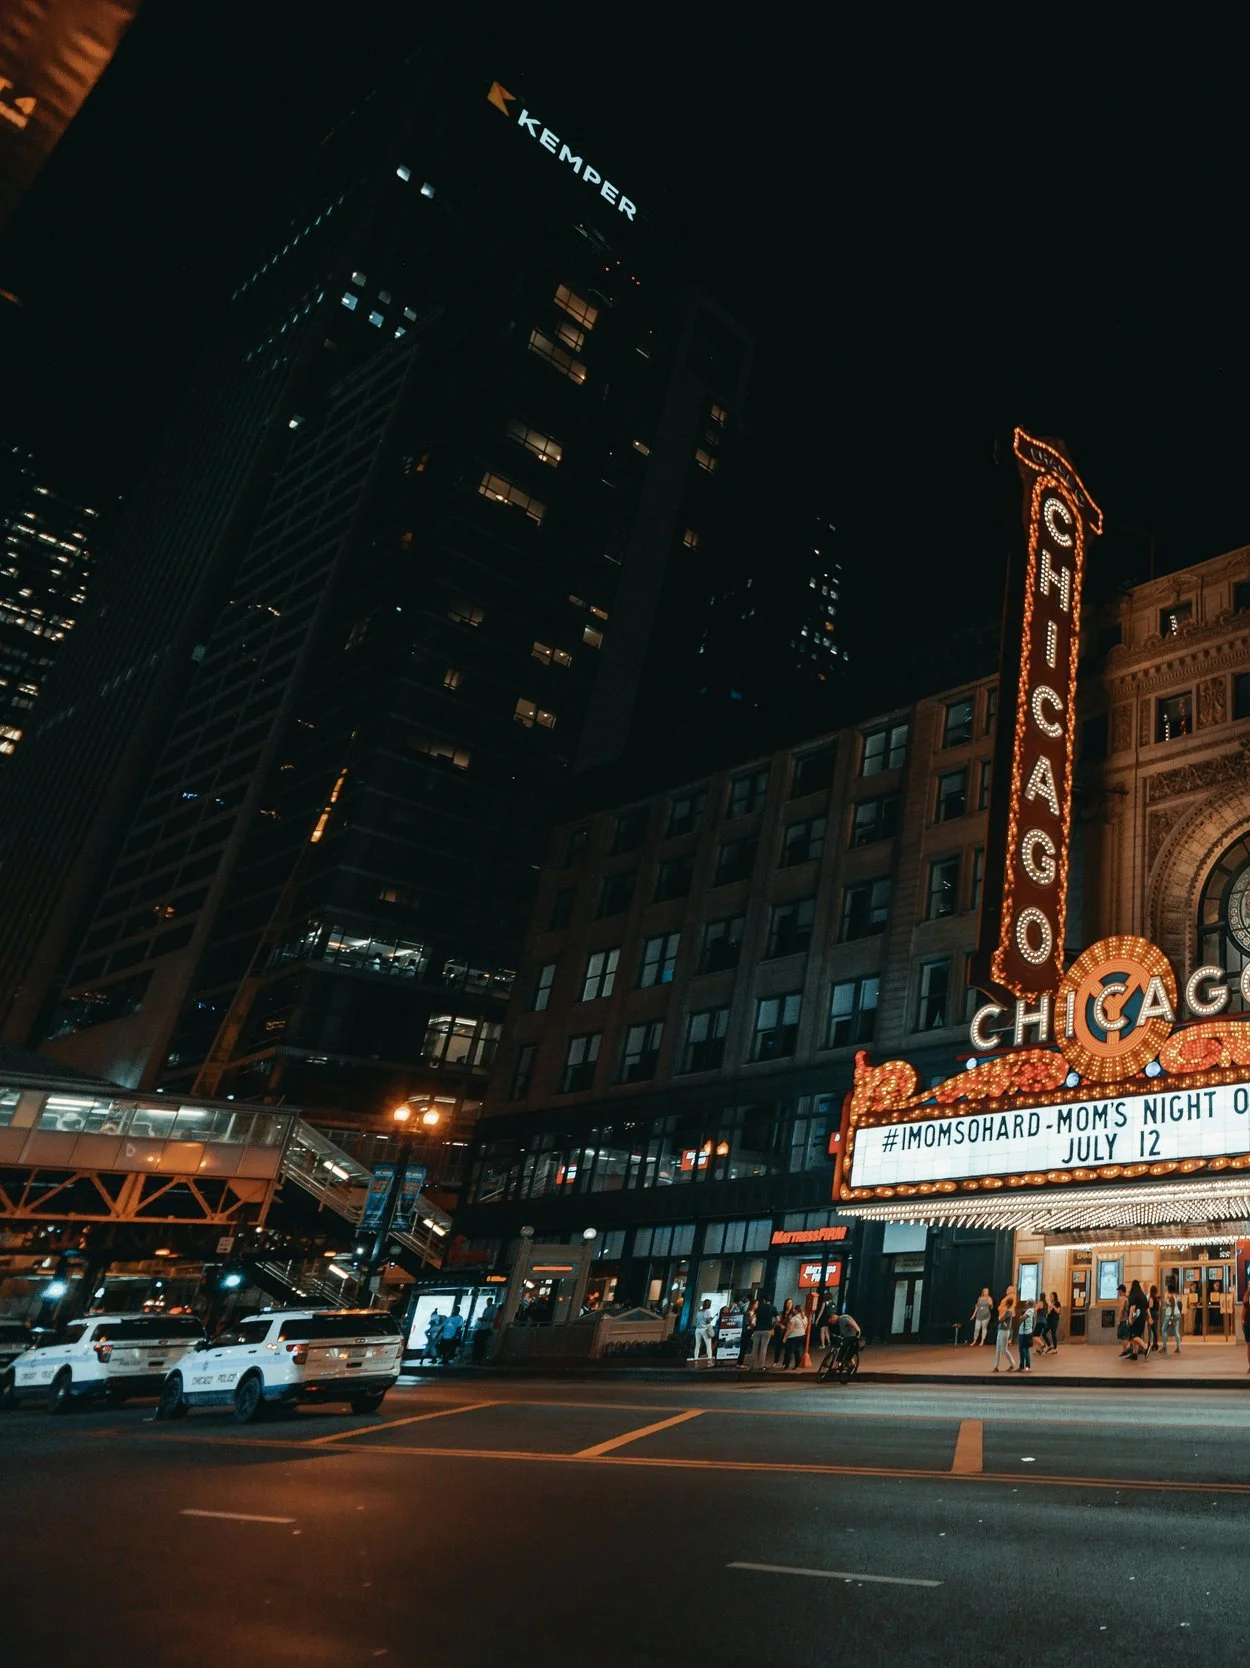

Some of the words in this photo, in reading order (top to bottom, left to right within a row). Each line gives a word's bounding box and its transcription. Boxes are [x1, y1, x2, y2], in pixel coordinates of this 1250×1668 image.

[517, 108, 637, 222] KEMPER
[1016, 497, 1073, 965] CHICAGO
[1143, 1090, 1217, 1126] NIGHT
[1061, 1132, 1118, 1164] JULY
[1139, 1129, 1161, 1158] 12
